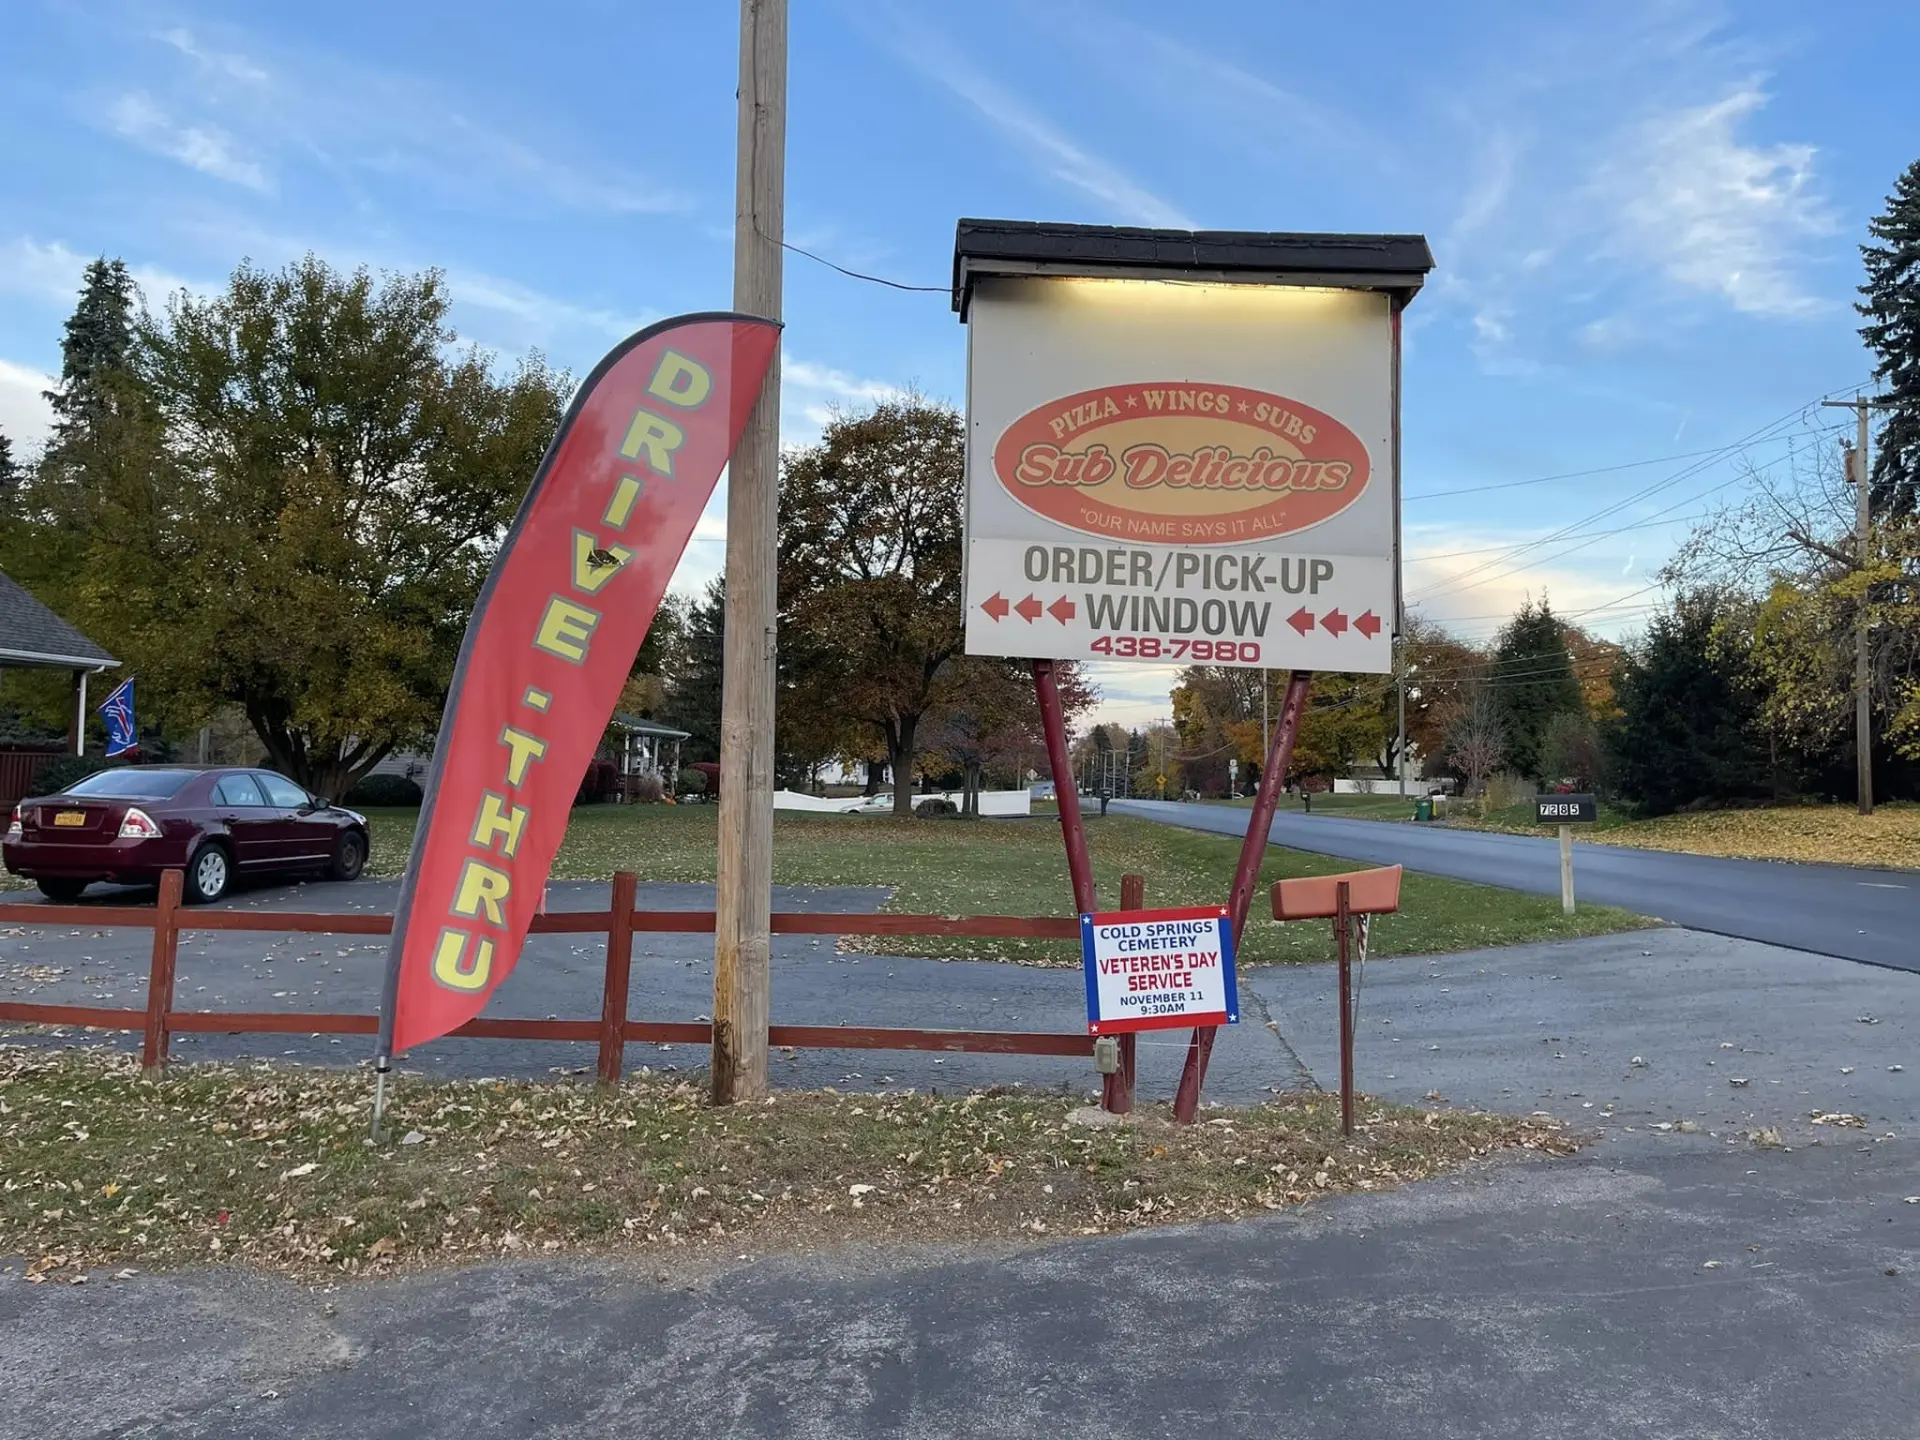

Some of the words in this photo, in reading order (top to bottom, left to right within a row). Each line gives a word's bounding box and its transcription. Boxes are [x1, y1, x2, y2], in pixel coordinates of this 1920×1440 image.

[1048, 396, 1121, 439] PIZZA
[1142, 390, 1230, 414] WINGS
[1253, 402, 1317, 444] SUBS
[1016, 442, 1116, 487] Sub
[1121, 443, 1353, 492] Delicious
[1080, 508, 1122, 531] "OUR
[1127, 518, 1177, 536] NAME
[1181, 521, 1227, 537] SAYS
[1231, 519, 1247, 533] IT
[1252, 511, 1287, 532] ALL"
[1023, 544, 1335, 595] ORDER/PICK-UP
[1085, 593, 1272, 637] WINDOW
[1090, 635, 1261, 663] 438-7980
[1540, 804, 1580, 815] 7285
[1100, 926, 1141, 940] COLD
[1146, 921, 1213, 937] SPRINGS
[1118, 936, 1197, 952] CEMETERY
[1099, 954, 1184, 975] VETEREN'S
[1188, 951, 1218, 969] DAY
[1128, 972, 1193, 992] SERVICE
[1120, 992, 1186, 1006] NOVEMBER
[1190, 991, 1204, 1001] 11
[1140, 1003, 1185, 1015] 9:30AM
